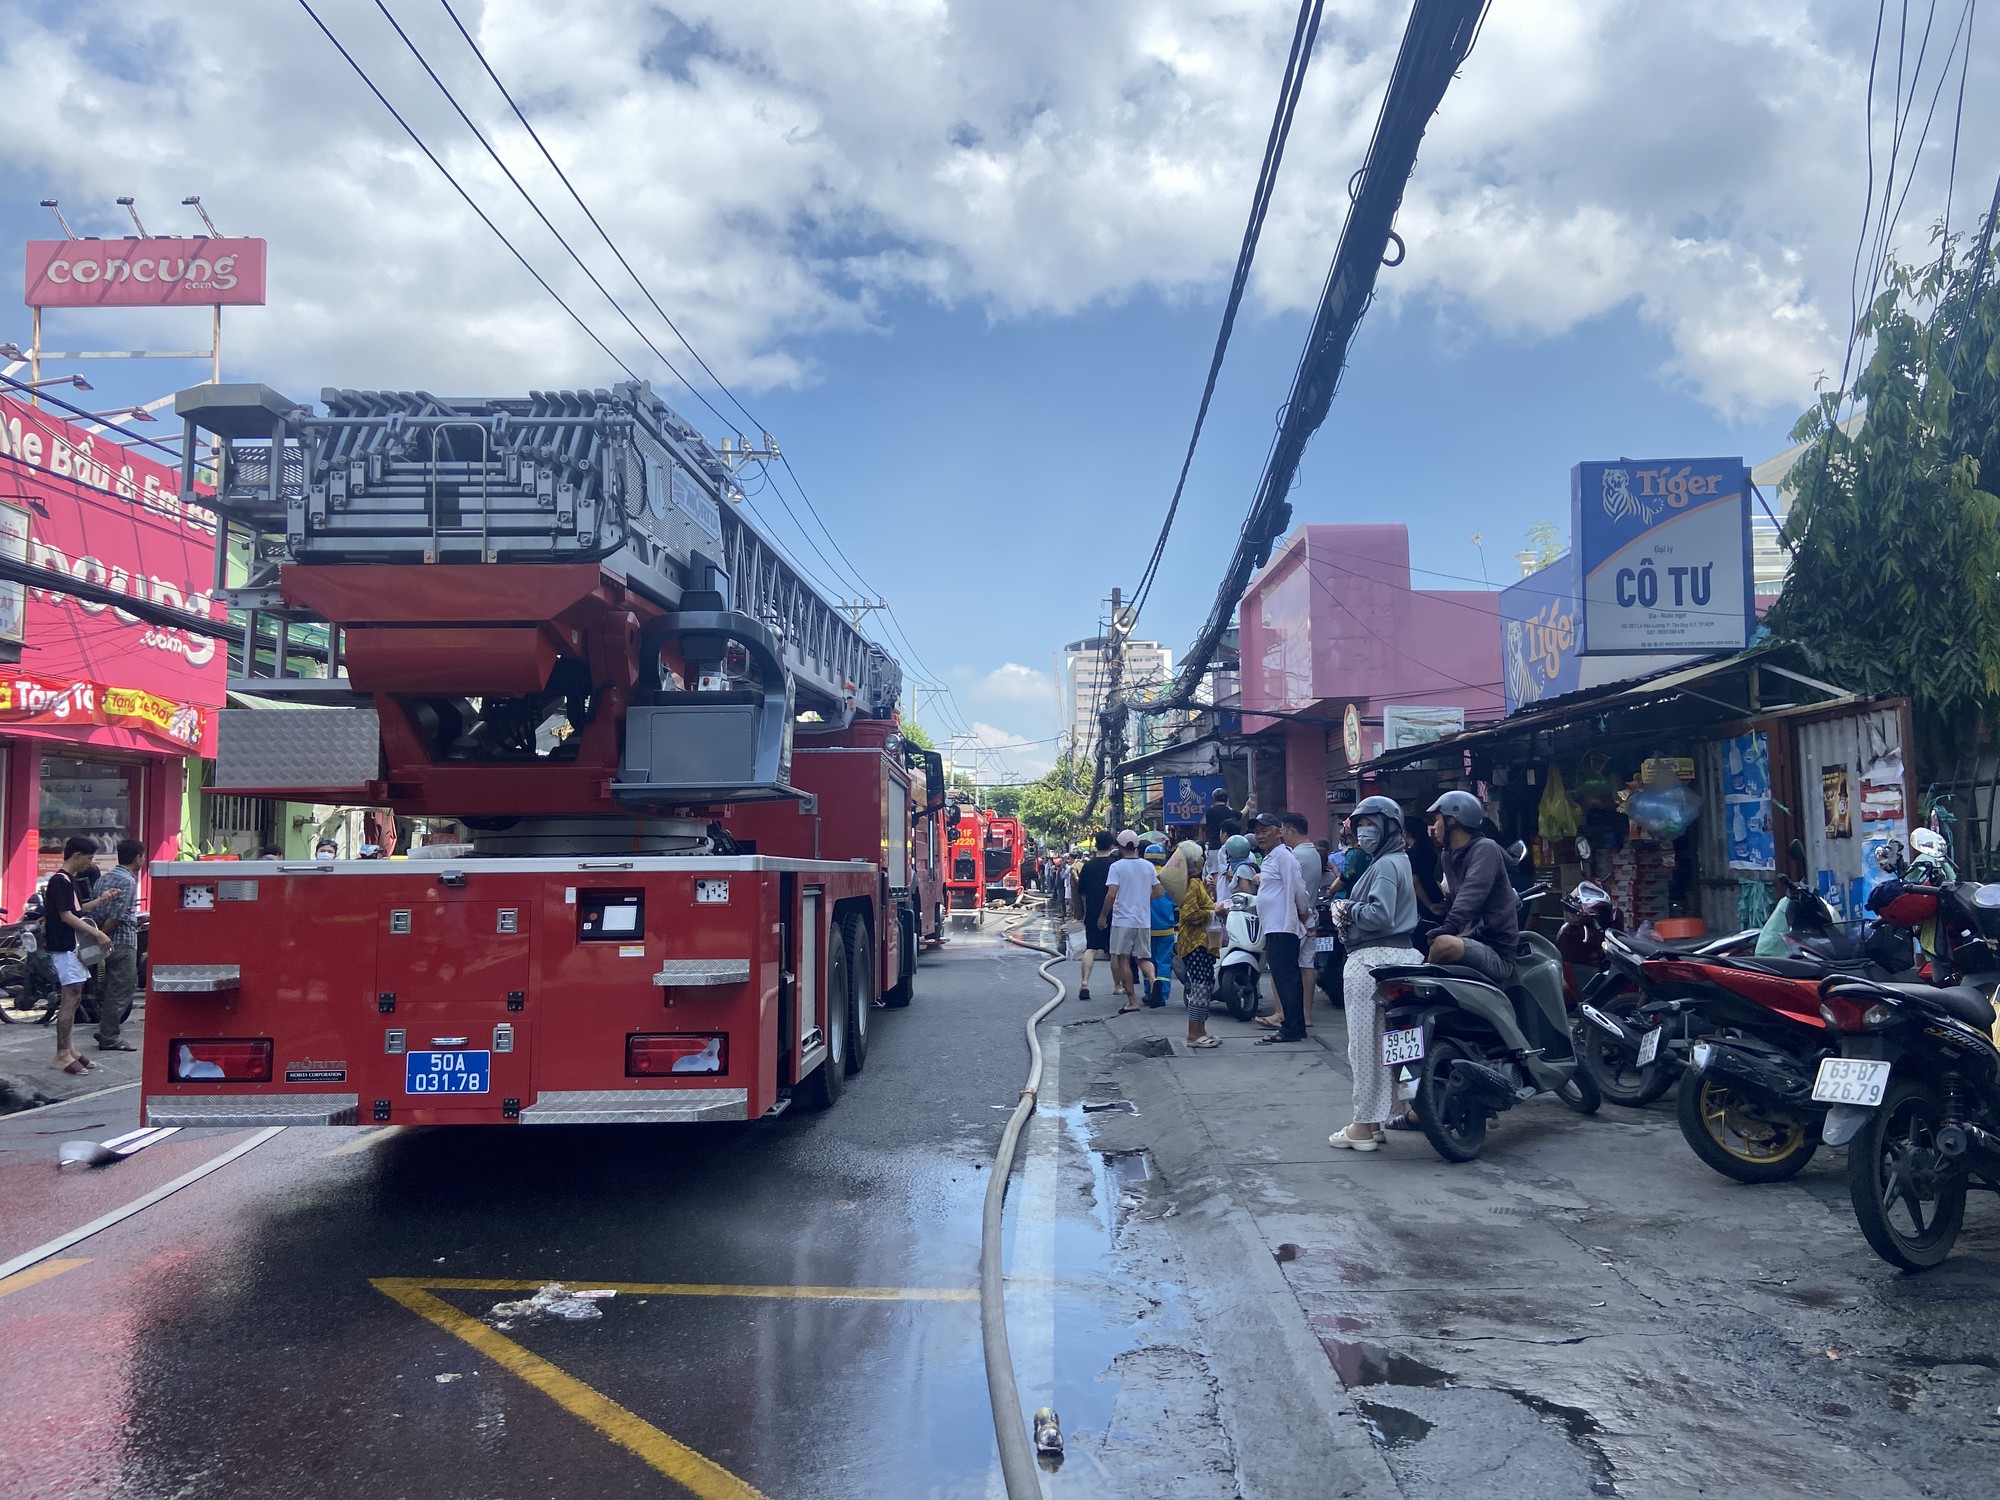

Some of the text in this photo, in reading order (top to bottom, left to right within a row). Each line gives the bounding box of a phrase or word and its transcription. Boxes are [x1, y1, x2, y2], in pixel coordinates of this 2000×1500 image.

[47, 253, 239, 291] concung
[182, 280, 212, 290] .com
[50, 435, 110, 494] Bầu
[143, 474, 182, 524] Em
[1635, 465, 1723, 508] Tiger
[1615, 557, 1714, 608] CÔ TƯ
[1167, 800, 1205, 820] Tiger
[1387, 1029, 1417, 1048] 59-C4
[1944, 1030, 1989, 1056] SIRIUS
[430, 1053, 465, 1072] 50A
[1385, 1043, 1421, 1063] 254.22
[415, 1072, 480, 1091] 031.78
[1829, 1061, 1879, 1082] 63-B7
[1817, 1080, 1881, 1103] 226.79
